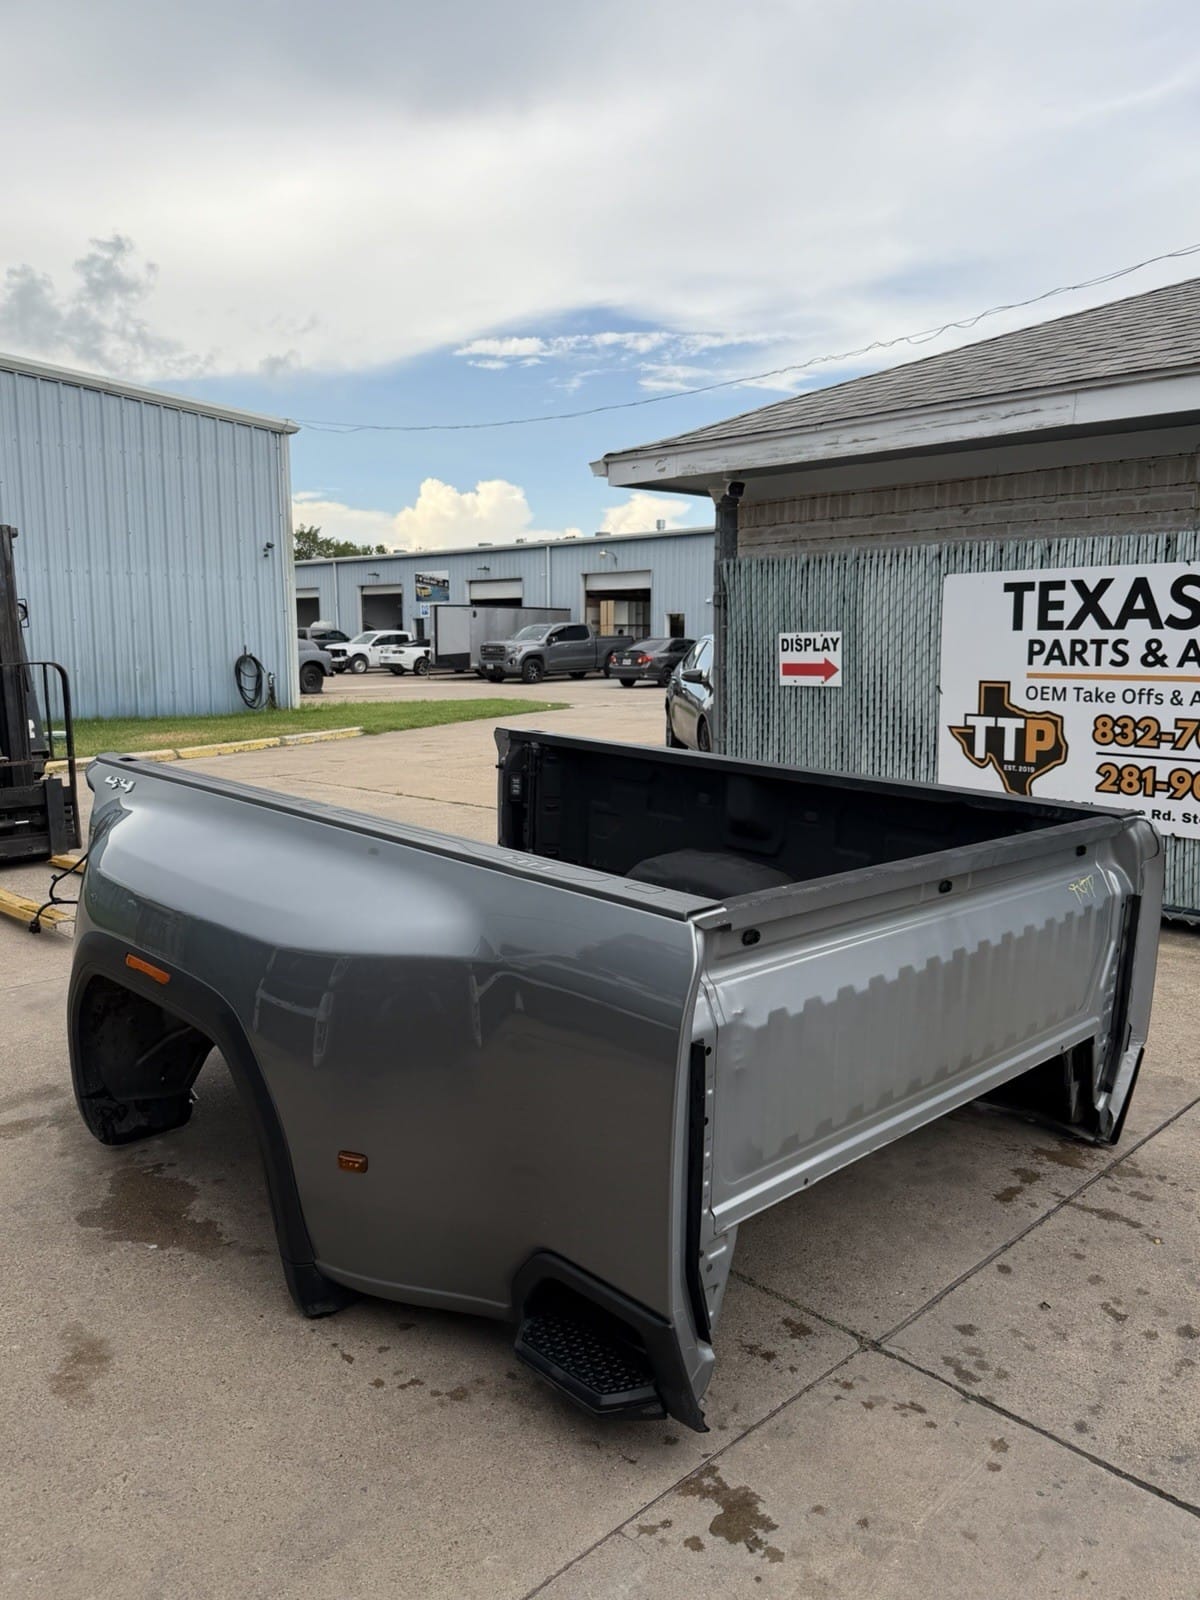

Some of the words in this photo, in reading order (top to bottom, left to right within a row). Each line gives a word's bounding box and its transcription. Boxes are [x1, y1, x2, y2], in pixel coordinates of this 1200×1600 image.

[1003, 574, 1200, 631] TEXAS
[781, 637, 840, 652] DISPLAY
[1027, 638, 1129, 667] PARTS
[1140, 638, 1169, 668] &
[1025, 686, 1067, 701] OEM
[1073, 687, 1116, 704] Take
[1122, 688, 1164, 705] Offs
[1170, 690, 1184, 706] &
[965, 714, 1057, 763] TTP
[1092, 714, 1200, 751] 832-7
[1003, 764, 1018, 772] EST.
[1151, 809, 1176, 822] Rd.
[1181, 812, 1200, 825] St
